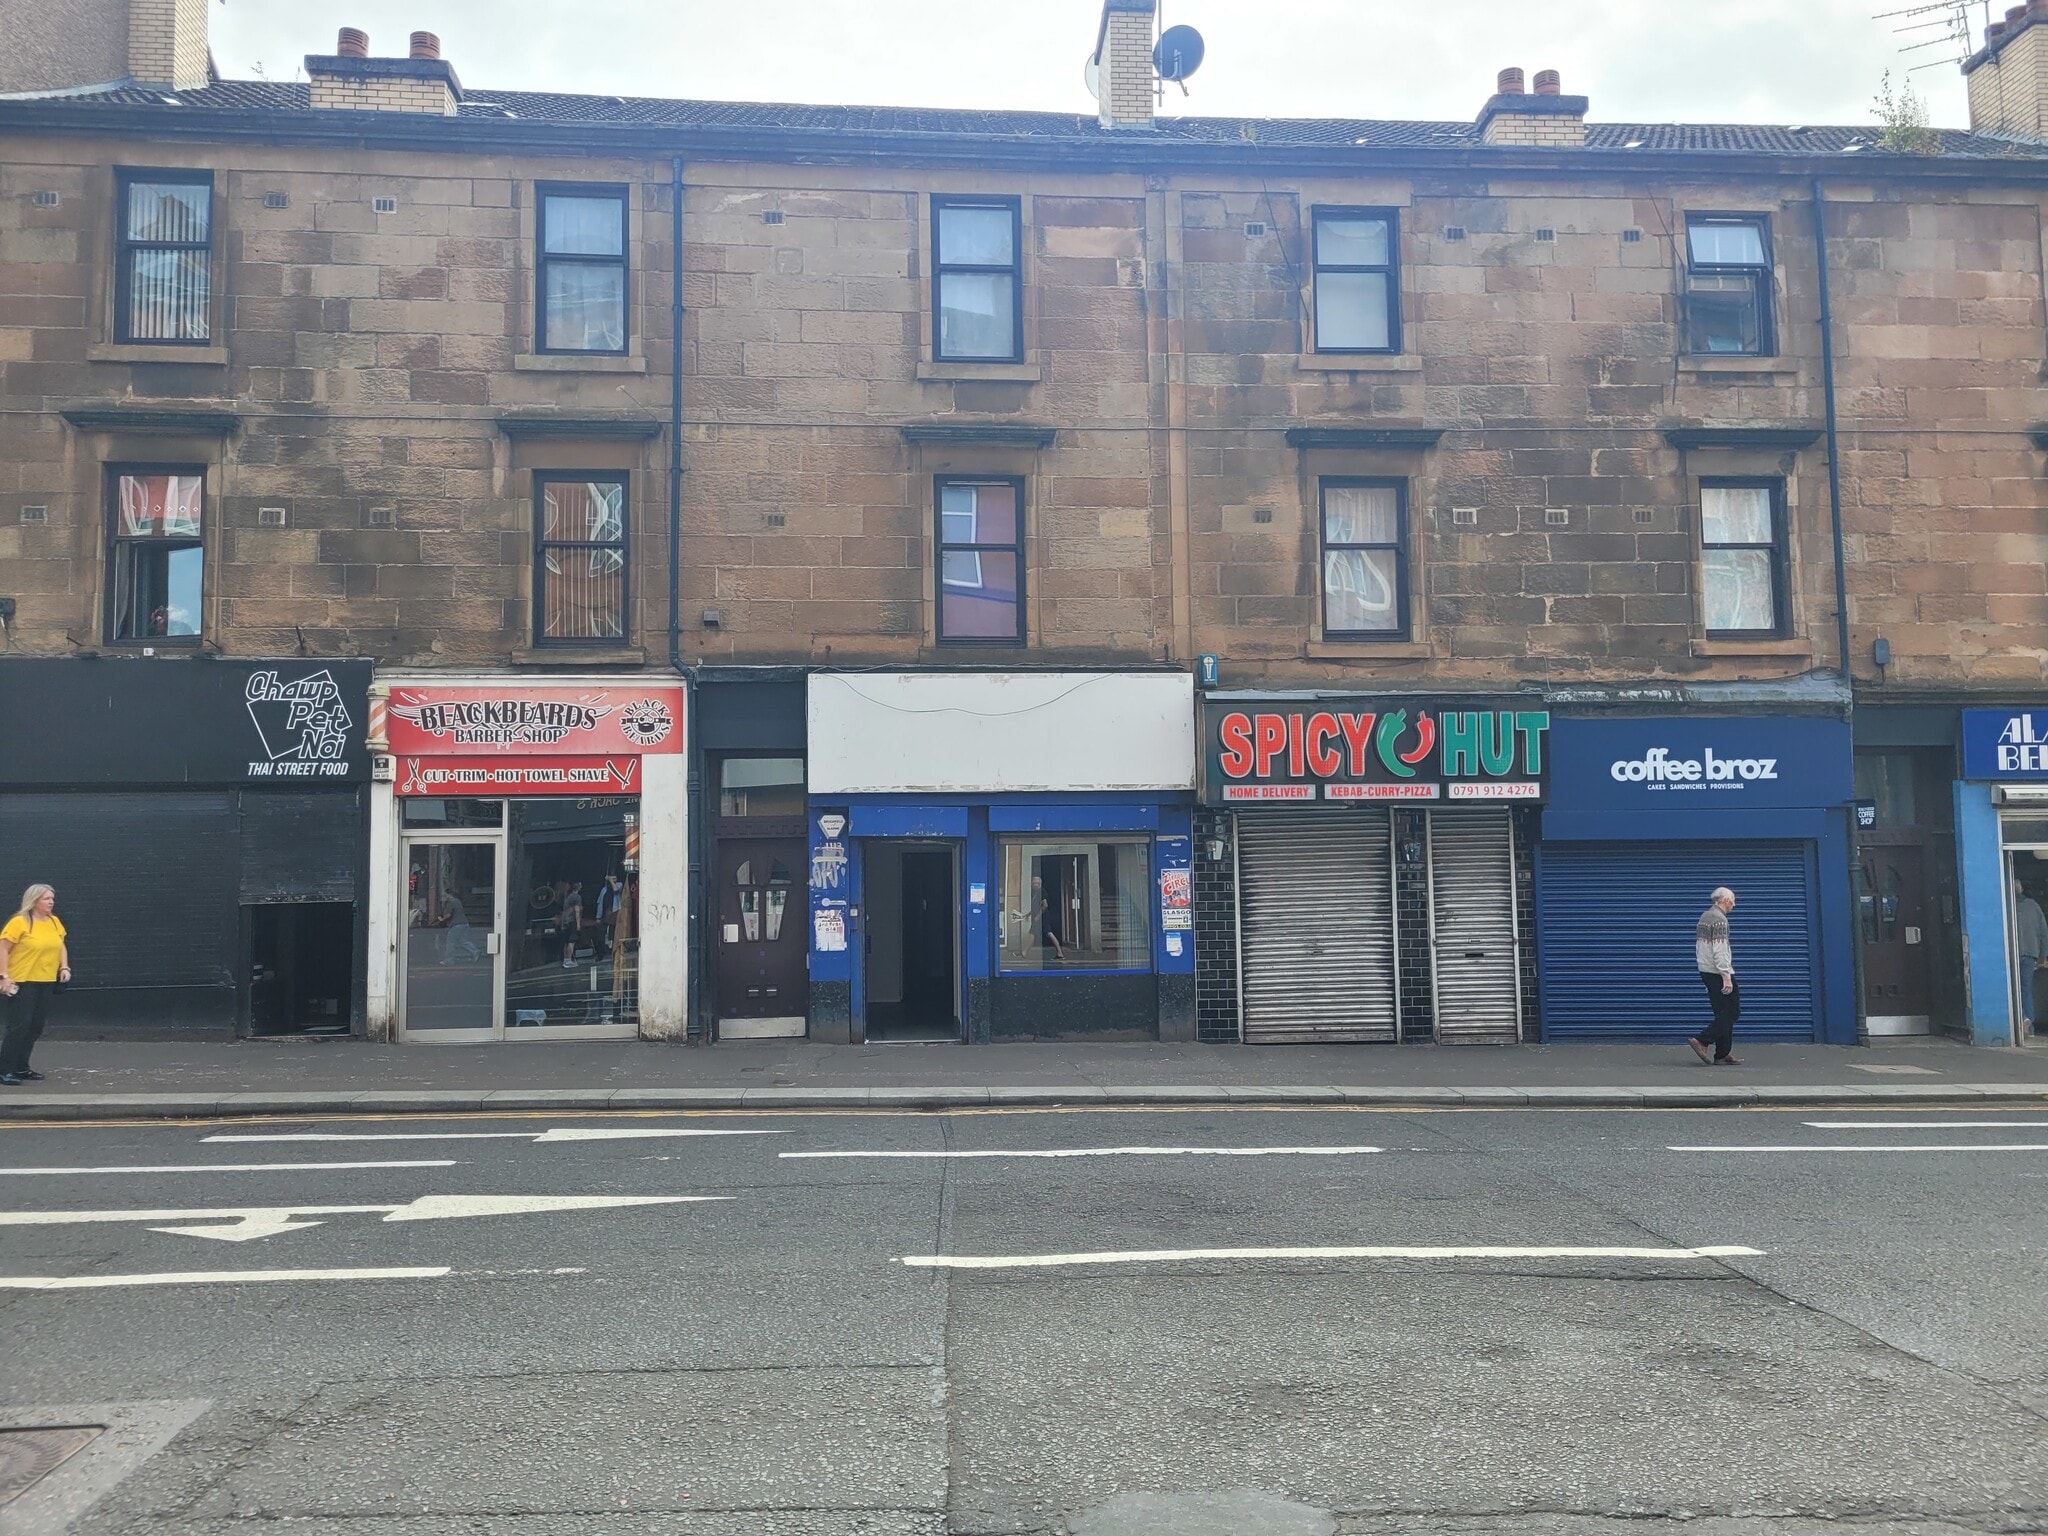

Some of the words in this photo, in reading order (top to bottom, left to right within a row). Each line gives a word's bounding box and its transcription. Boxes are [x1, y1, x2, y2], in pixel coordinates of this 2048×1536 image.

[246, 671, 338, 707] Chawp
[420, 701, 598, 731] BLACKBEARDS
[624, 699, 668, 716] BLACK
[286, 700, 345, 737] Pet
[1998, 713, 2048, 743] AL
[298, 729, 347, 759] Noi
[455, 729, 513, 742] BARBER
[522, 729, 563, 742] SHOP
[622, 725, 671, 745] BEARDS
[1220, 712, 1377, 778] SPICY
[1441, 711, 1549, 776] HUT
[248, 762, 275, 776] THAI
[276, 762, 319, 776] STREET
[319, 762, 349, 776] FOOD
[424, 770, 448, 781] CUT
[456, 770, 486, 781] TRIM
[496, 770, 522, 781] HOT
[525, 770, 566, 781] TOWEL
[569, 769, 608, 780] SHAVE
[1610, 748, 1702, 782] coffee
[1705, 748, 1778, 780] broz
[1229, 787, 1259, 798] HOME
[1262, 786, 1309, 798] DELIVERY
[1331, 786, 1432, 797] KEBAB-CURRY-PIZZA
[1453, 785, 1480, 796] 0791
[1484, 785, 1505, 796] 912
[1507, 784, 1535, 795] 4276
